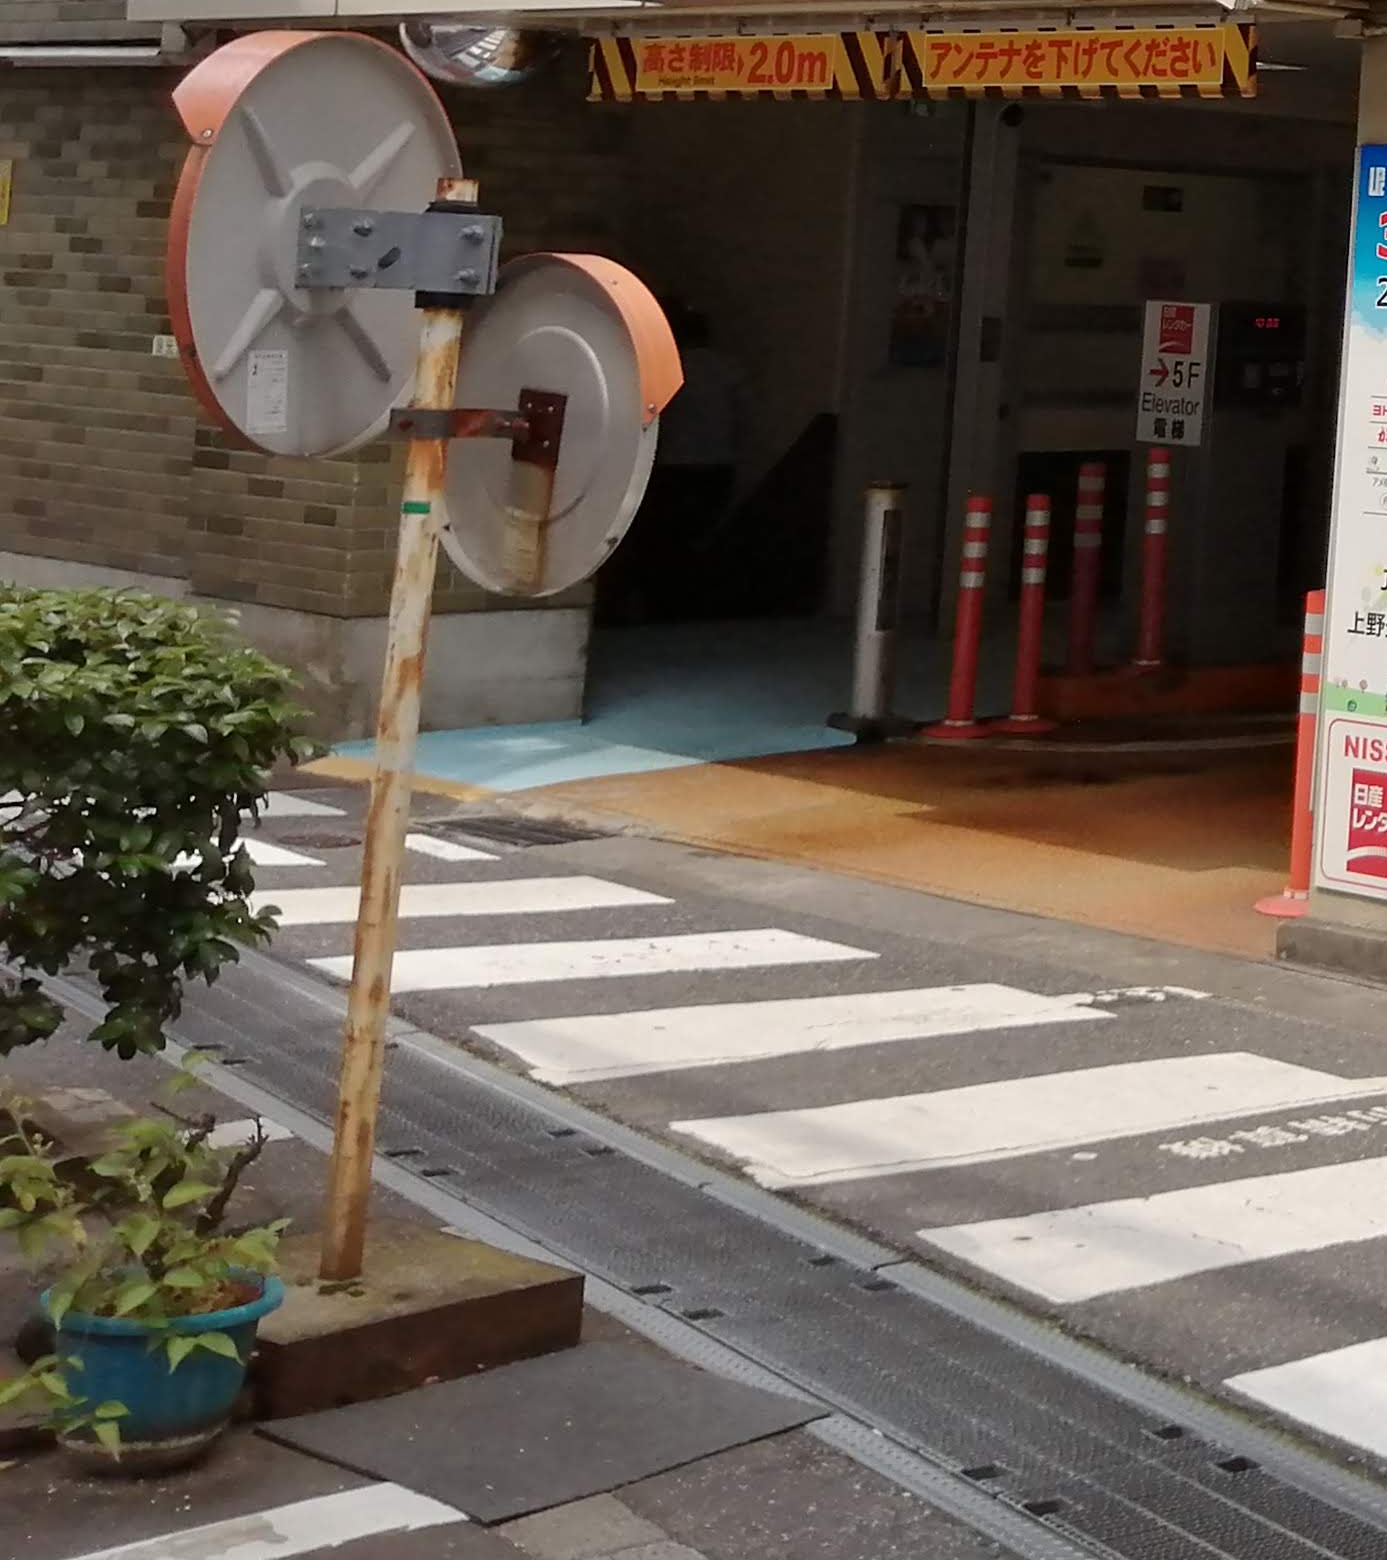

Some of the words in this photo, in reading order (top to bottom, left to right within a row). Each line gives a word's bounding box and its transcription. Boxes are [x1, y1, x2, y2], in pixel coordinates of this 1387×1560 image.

[643, 43, 735, 73] 高さ制限
[747, 40, 828, 84] 2.0m
[928, 32, 1219, 82] アンテナを下げてください
[1140, 391, 1201, 417] Elevator
[1353, 783, 1384, 809] 日産
